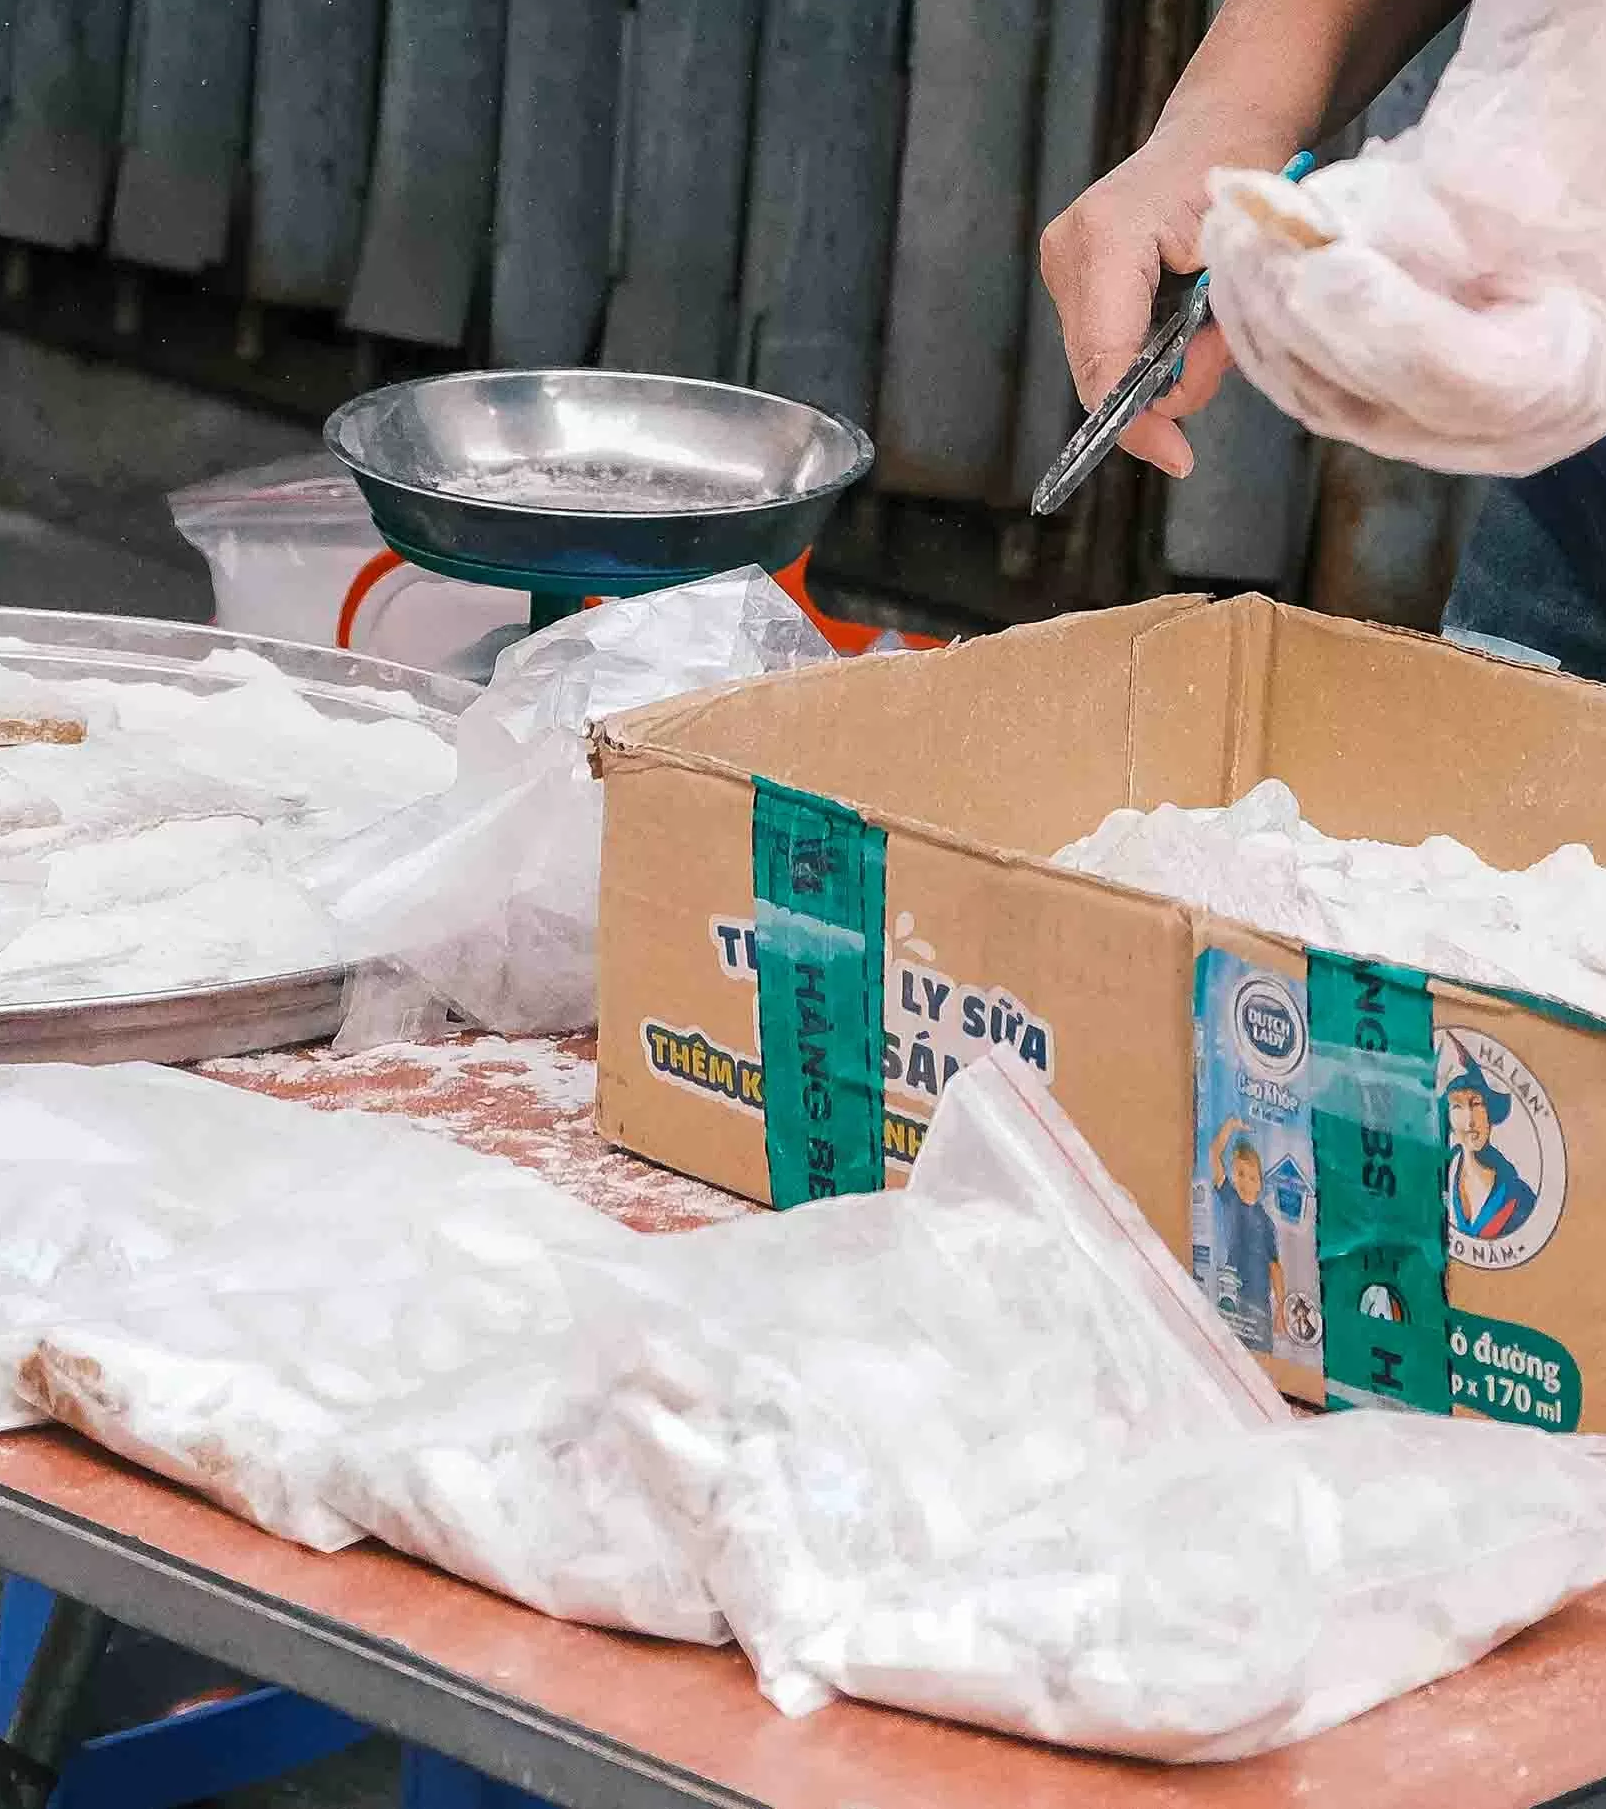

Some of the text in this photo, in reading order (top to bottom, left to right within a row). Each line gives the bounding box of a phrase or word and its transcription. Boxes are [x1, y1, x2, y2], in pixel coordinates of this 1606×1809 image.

[901, 969, 951, 1022] LY
[1248, 1007, 1290, 1038] DUTCH
[1252, 1024, 1286, 1049] LADY
[650, 1029, 736, 1094] THÊM
[1450, 1325, 1561, 1394] ó đường
[1467, 1379, 1478, 1398] x
[1484, 1374, 1531, 1412] 170
[1535, 1399, 1562, 1423] ml
